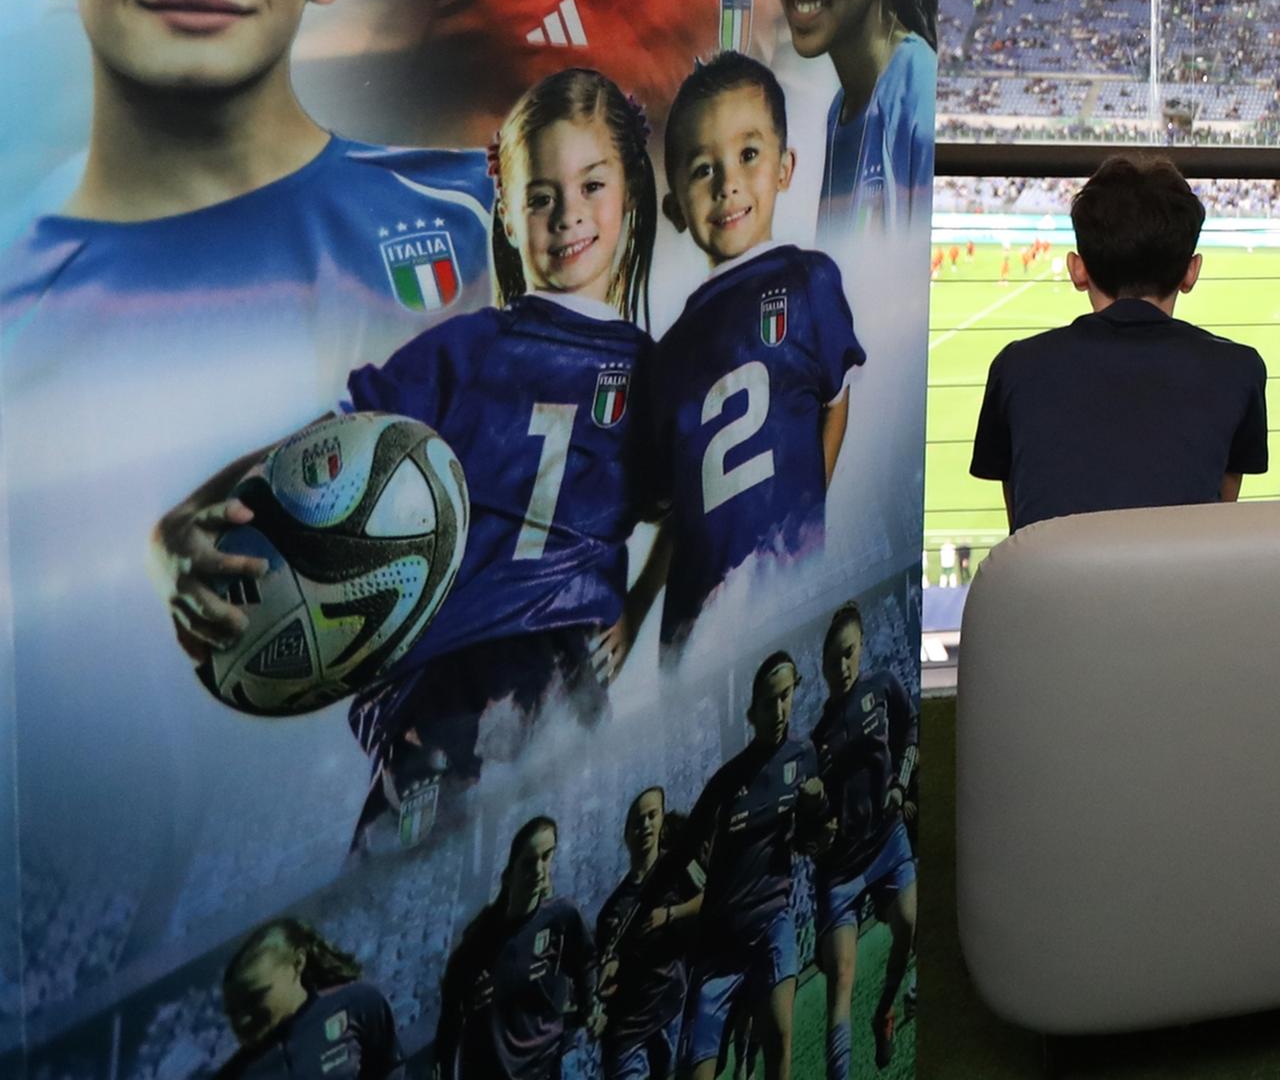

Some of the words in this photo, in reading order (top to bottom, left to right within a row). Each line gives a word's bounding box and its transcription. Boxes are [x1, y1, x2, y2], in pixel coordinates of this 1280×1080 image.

[387, 237, 447, 262] ITALIA
[600, 375, 627, 385] ITALIA
[512, 402, 579, 561] 1
[701, 360, 775, 514] 2
